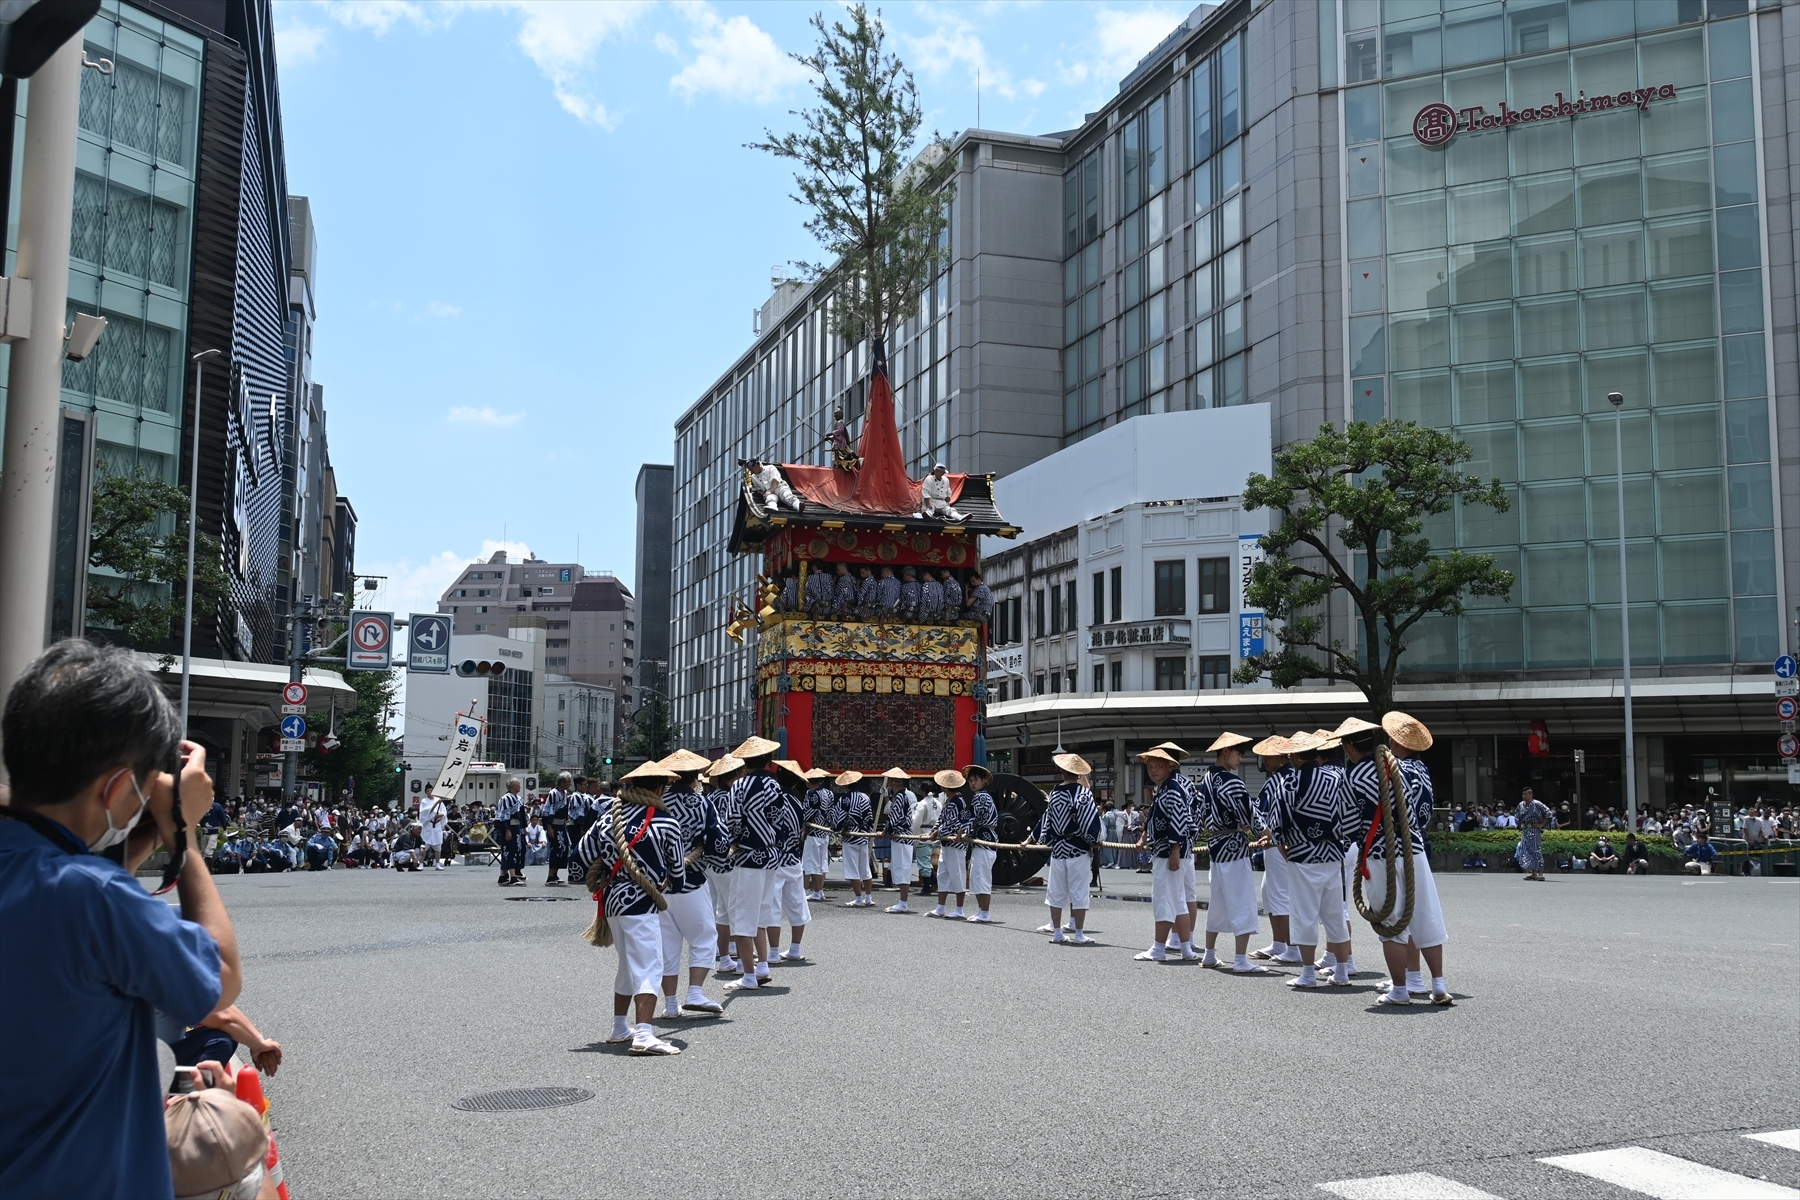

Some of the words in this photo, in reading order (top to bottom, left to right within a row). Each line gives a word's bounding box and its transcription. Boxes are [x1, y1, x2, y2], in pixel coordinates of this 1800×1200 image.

[1460, 83, 1677, 132] Takashimaya
[1091, 626, 1164, 647] 池善化粧品店
[1242, 617, 1251, 657] 買えます
[1252, 617, 1262, 638] すぐ
[412, 655, 447, 665] 路線バスを除く
[441, 738, 469, 789] 岩戸山
